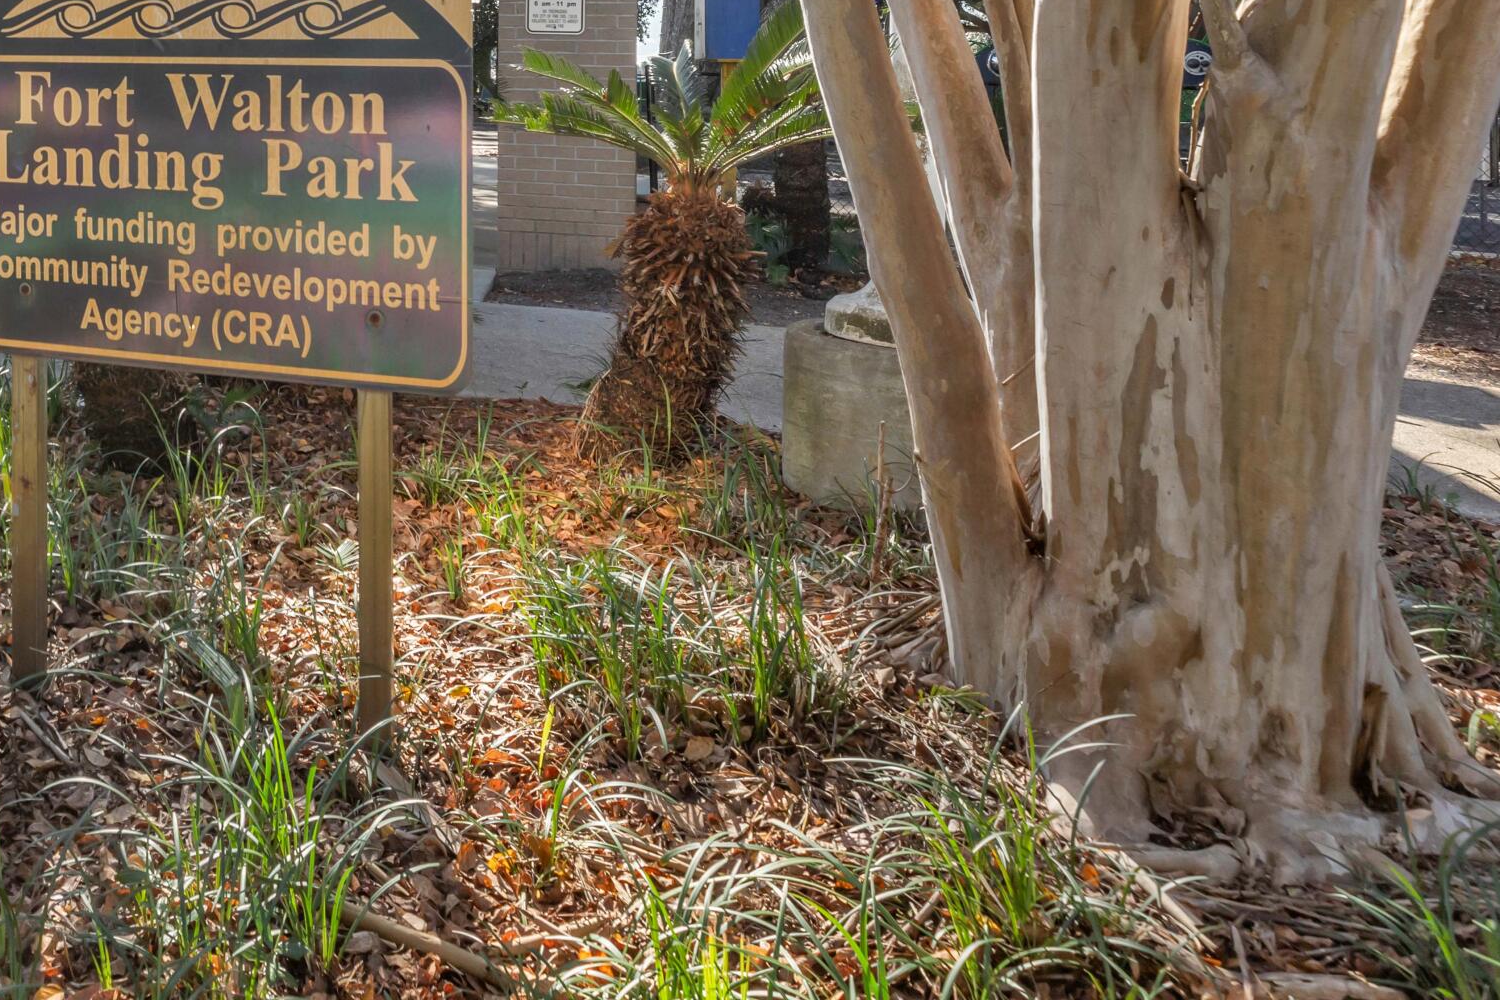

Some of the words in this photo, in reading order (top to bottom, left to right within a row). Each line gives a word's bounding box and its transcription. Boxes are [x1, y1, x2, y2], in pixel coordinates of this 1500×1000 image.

[15, 70, 134, 127] Fort
[167, 73, 386, 136] Walton
[262, 138, 418, 202] Park
[74, 207, 196, 256] funding
[216, 220, 370, 258] provided
[392, 225, 437, 271] by
[167, 259, 441, 312] Redevelopment
[80, 298, 201, 348] Agency
[211, 308, 312, 358] (CRA)
